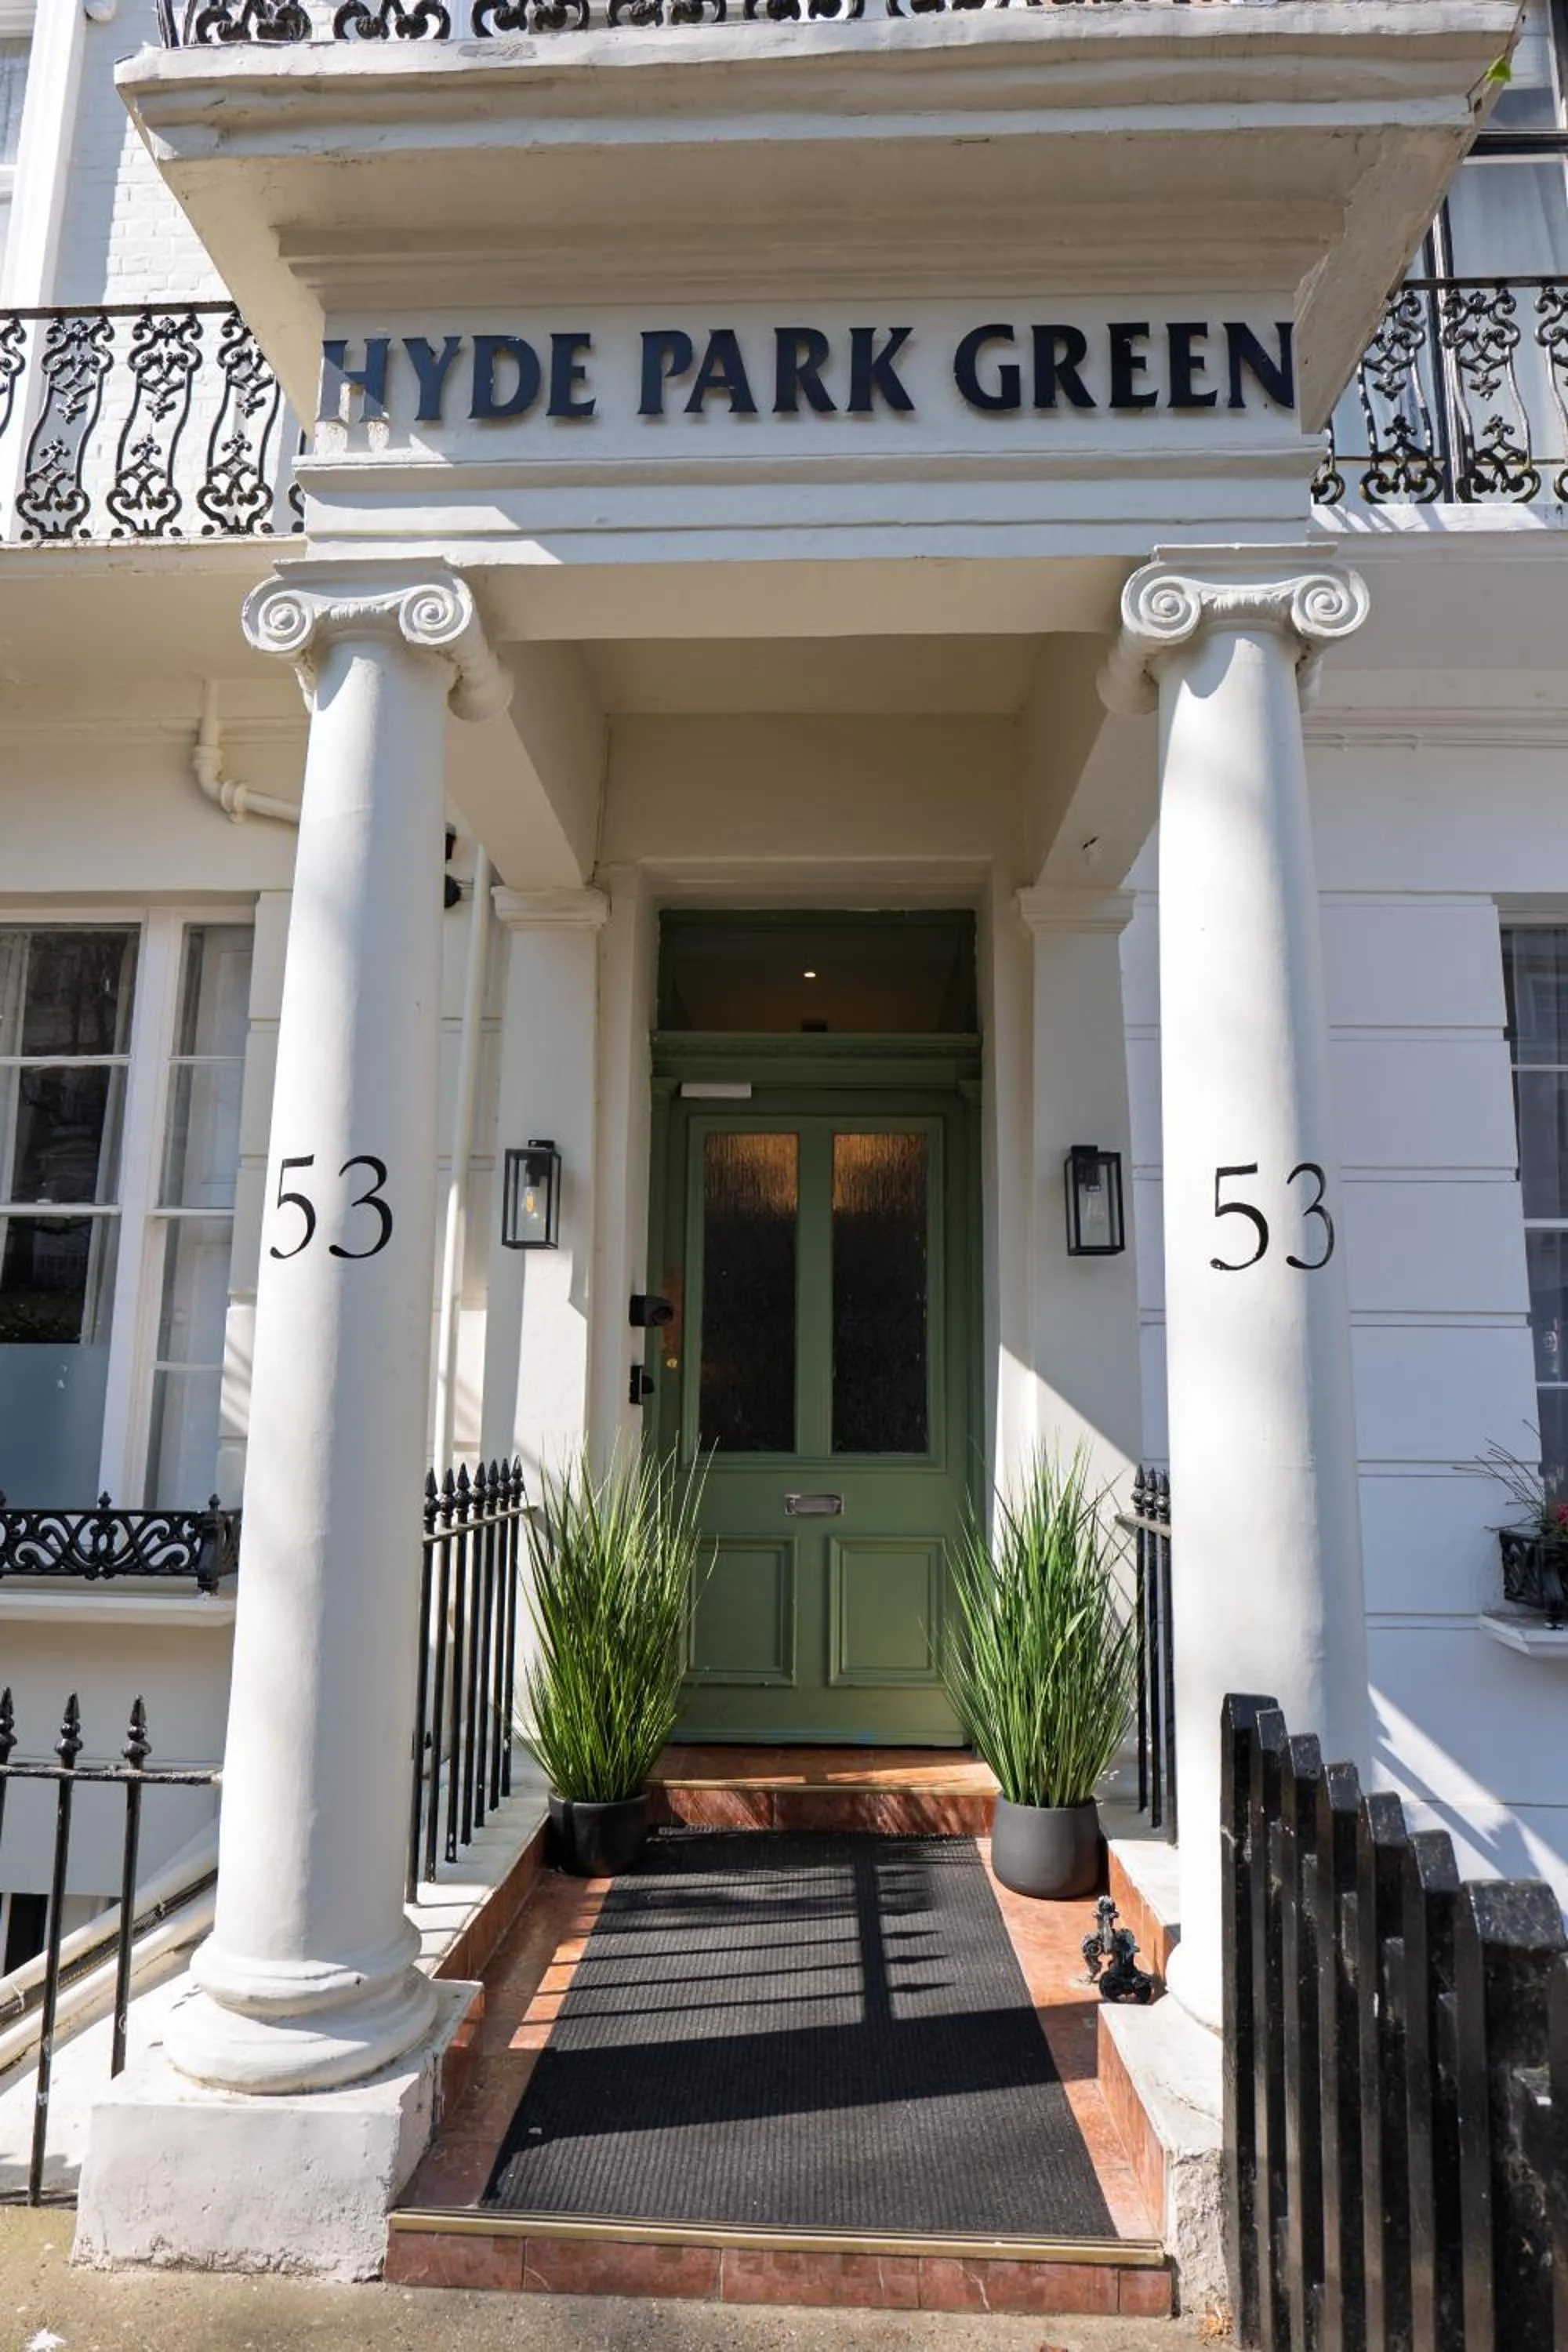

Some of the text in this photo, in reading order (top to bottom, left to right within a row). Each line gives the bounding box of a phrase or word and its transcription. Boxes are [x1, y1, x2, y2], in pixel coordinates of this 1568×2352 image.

[318, 321, 1295, 423] HYDE PARK GREEN
[270, 1154, 393, 1260] 53
[1210, 1162, 1335, 1271] 53
